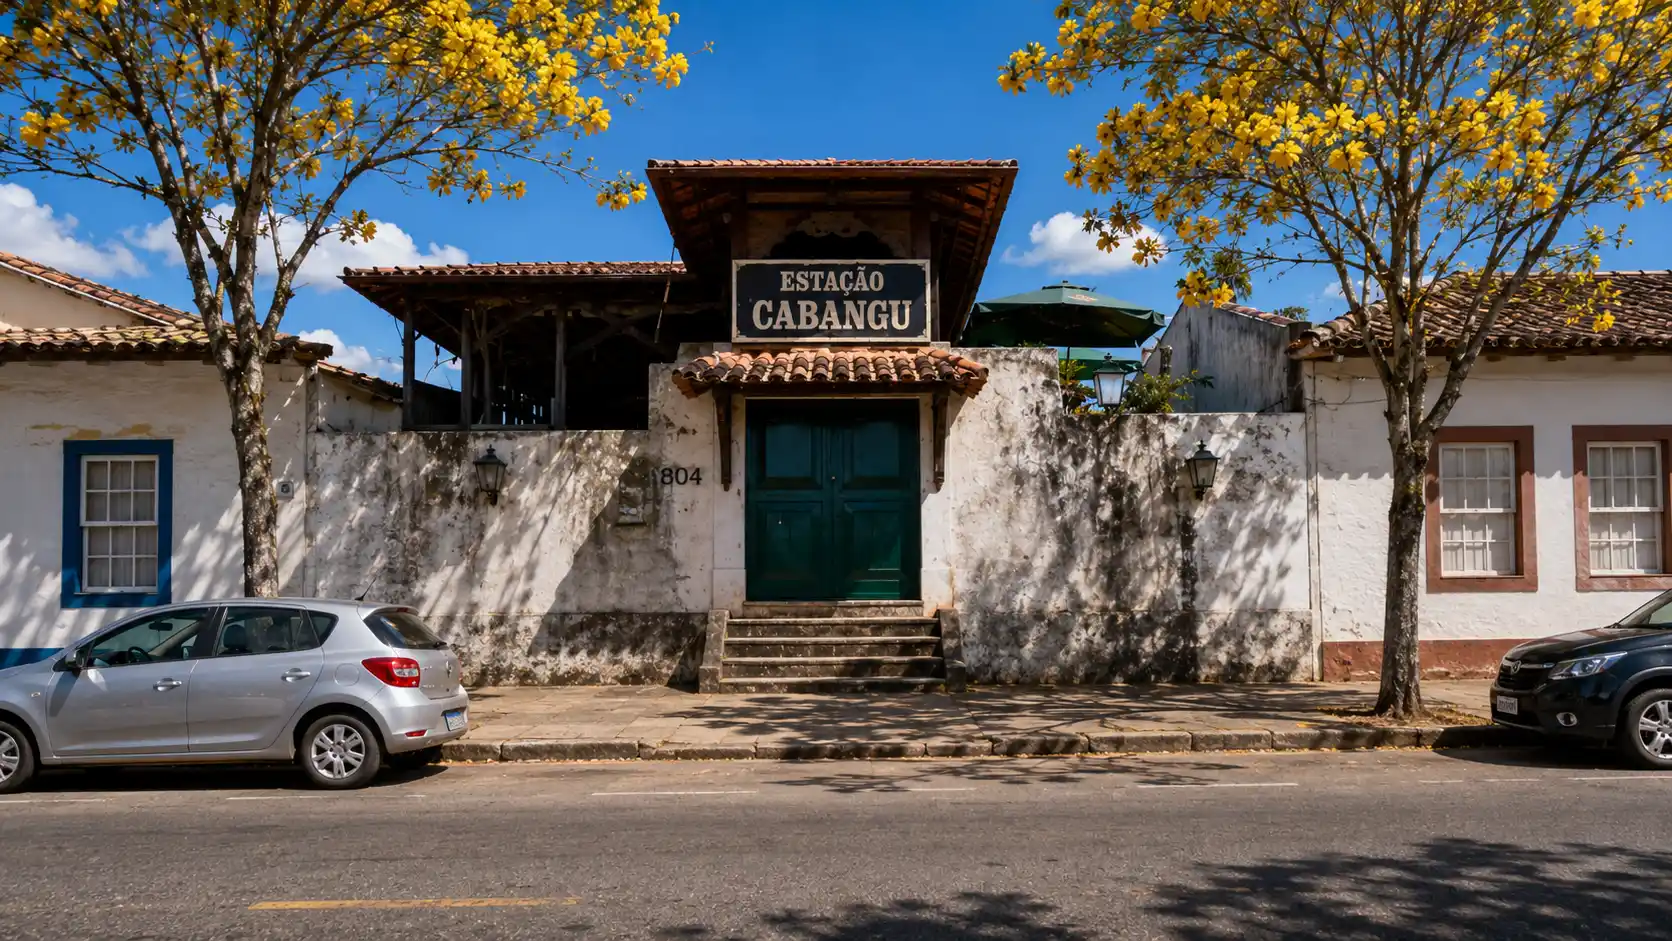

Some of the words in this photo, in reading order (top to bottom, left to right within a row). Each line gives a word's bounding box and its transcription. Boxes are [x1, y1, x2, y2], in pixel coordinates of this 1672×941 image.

[780, 266, 884, 296] ESTAÇÃO
[752, 300, 912, 330] CABANGU
[660, 467, 702, 485] 804
